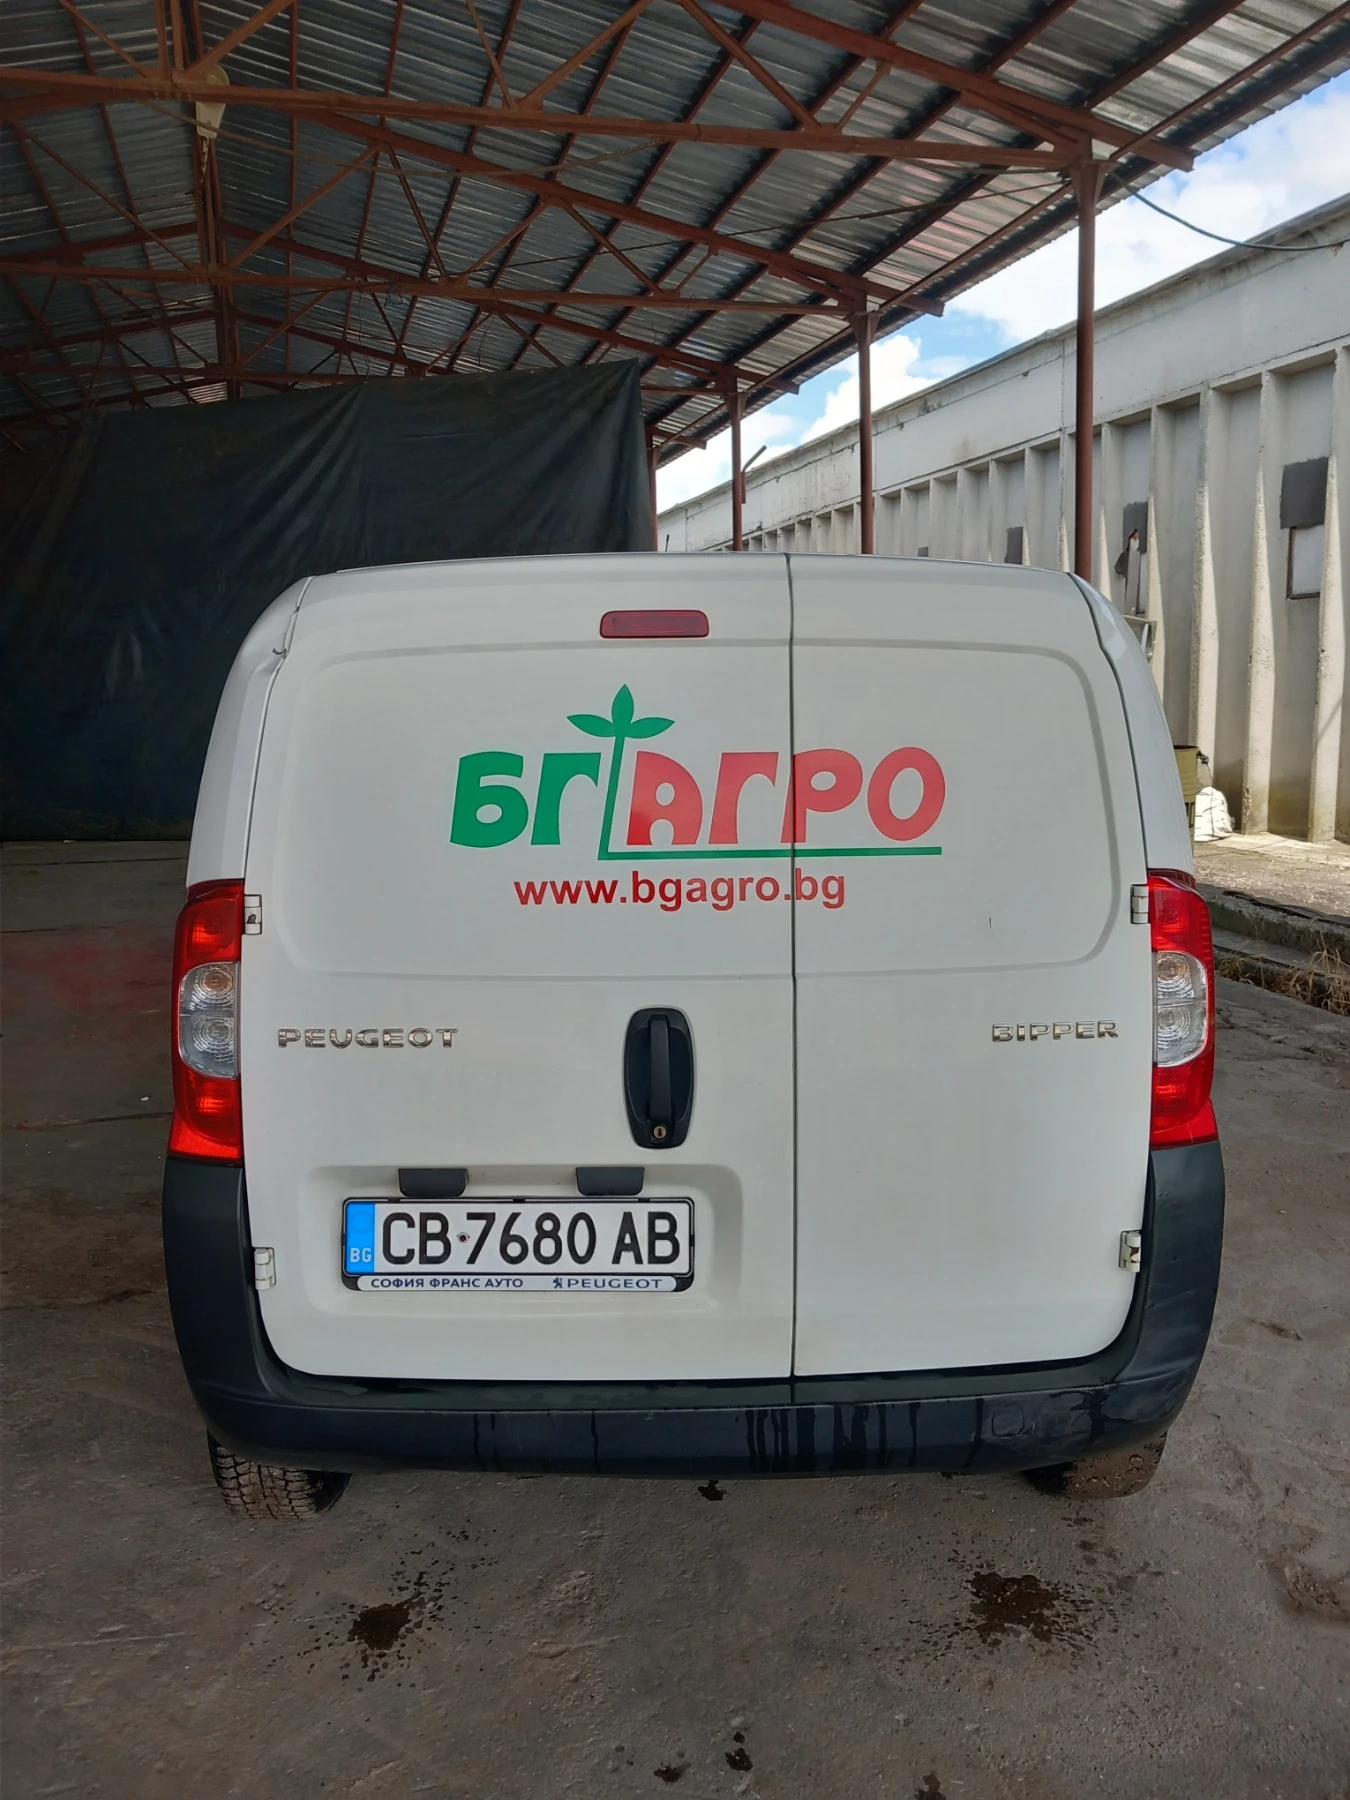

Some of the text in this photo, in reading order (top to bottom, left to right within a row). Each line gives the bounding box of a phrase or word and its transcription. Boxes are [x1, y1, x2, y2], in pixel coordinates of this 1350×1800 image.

[513, 868, 846, 912] www.bgagro.bg
[277, 1027, 459, 1049] PEUGEOT
[991, 1019, 1119, 1042] BIPPER
[465, 1211, 597, 1265] 7680
[349, 1247, 373, 1264] BG
[370, 1277, 524, 1289] СОФИЯ ФРАНС АУТО
[567, 1278, 663, 1289] PEUGEOT
